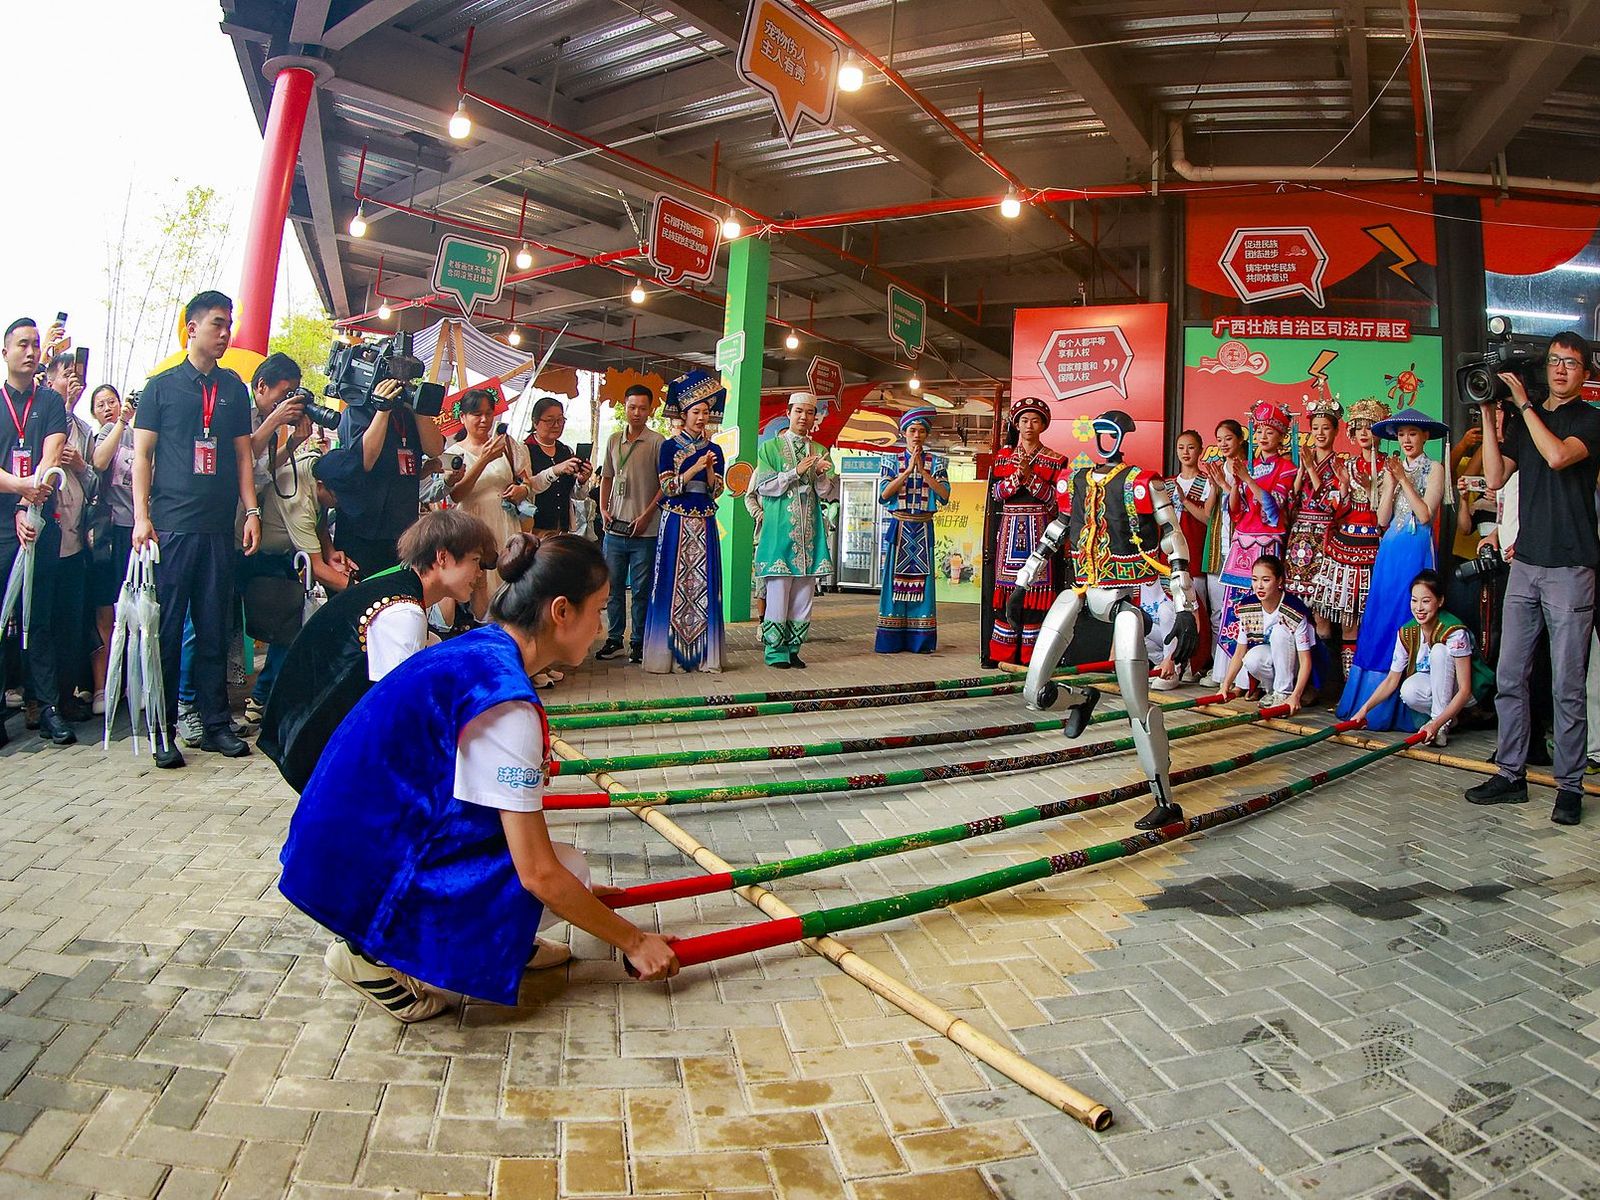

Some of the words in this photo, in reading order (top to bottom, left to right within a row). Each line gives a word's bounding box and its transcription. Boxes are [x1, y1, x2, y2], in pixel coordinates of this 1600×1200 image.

[764, 19, 808, 66] 宠物伤人
[760, 40, 807, 85] 主人有责
[1243, 239, 1278, 249] 促进民族
[1244, 249, 1279, 258] 团结进步
[1245, 263, 1296, 272] 铸牢中华民族
[1245, 273, 1289, 282] 共同体意识
[1215, 318, 1408, 339] 广西壮族自治区司法厅展区
[1058, 336, 1106, 349] 每个人都平等
[1058, 348, 1090, 358] 享有人权
[1057, 361, 1098, 373] 国家尊重和
[1057, 373, 1091, 383] 保障人权
